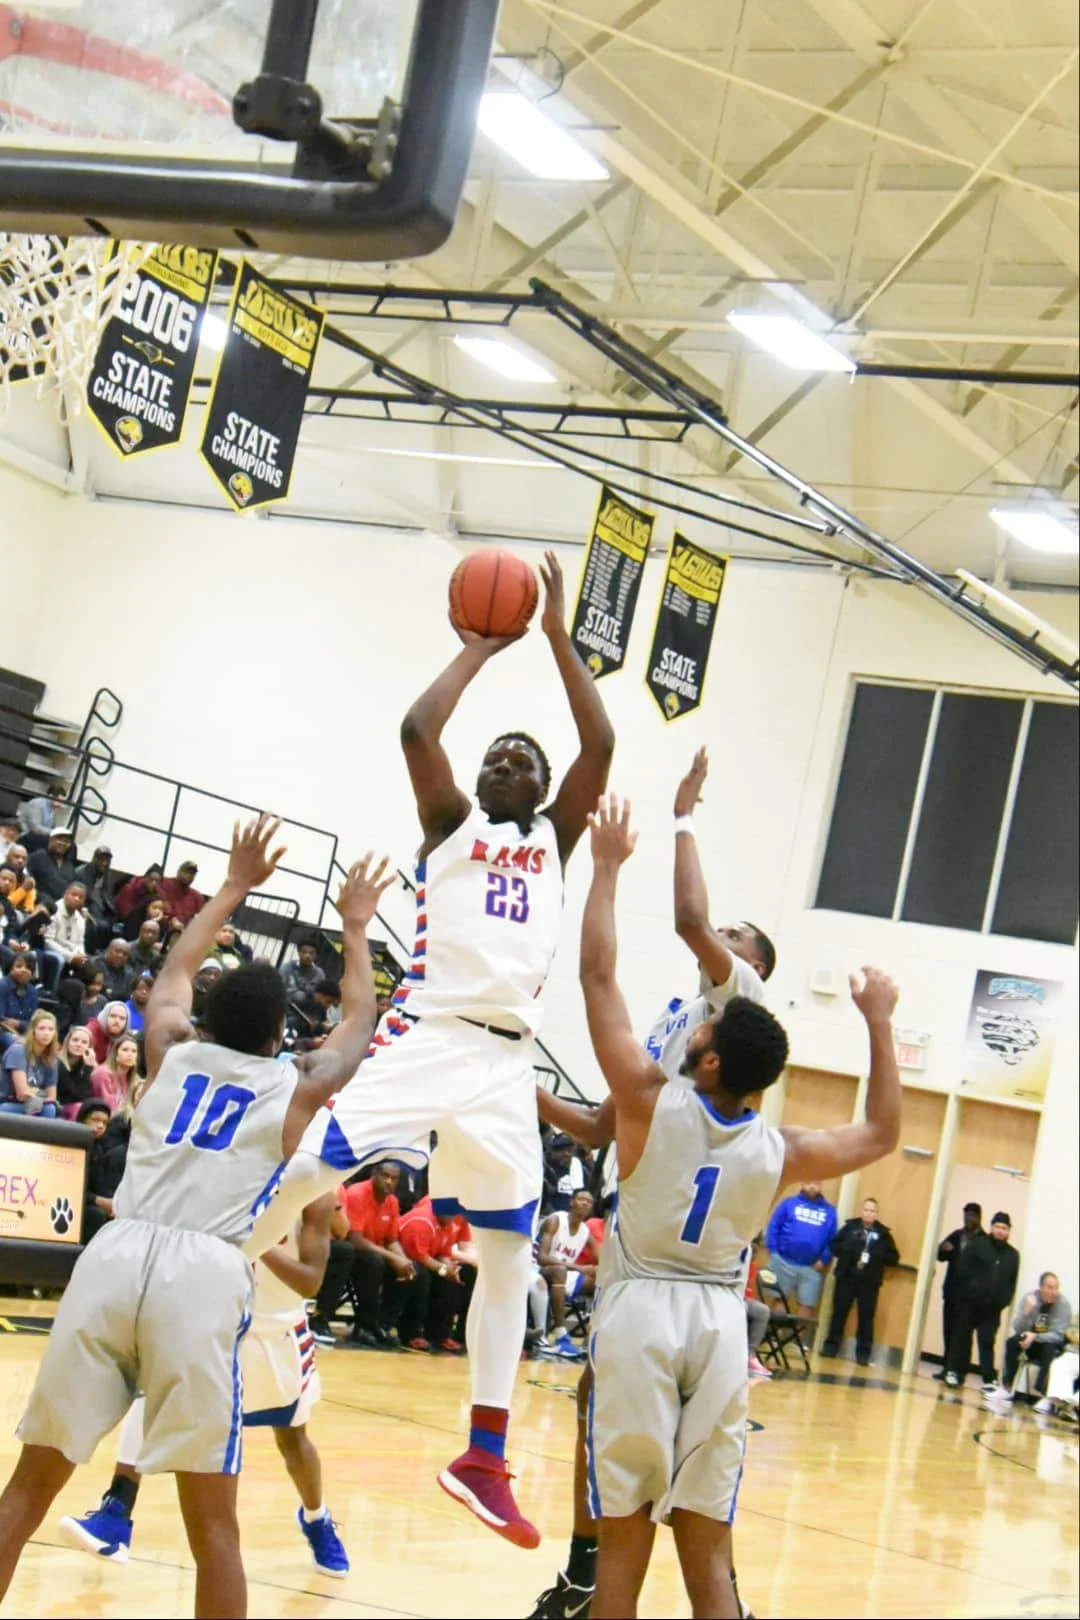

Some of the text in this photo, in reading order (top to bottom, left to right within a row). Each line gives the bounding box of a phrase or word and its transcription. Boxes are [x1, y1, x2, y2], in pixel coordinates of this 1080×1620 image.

[114, 272, 198, 353] 2006
[93, 376, 176, 433] CHAMPIONS
[108, 351, 174, 409] STATE
[211, 435, 283, 489] CHAMPIONS
[223, 411, 281, 466] STATE
[576, 625, 623, 662] CHAMPIONS
[584, 606, 622, 643] STATE
[652, 668, 698, 701] CHAMPIONS
[660, 648, 697, 683] STATE
[485, 871, 530, 924] 23
[164, 1072, 257, 1153] 10
[680, 1164, 723, 1248] 1
